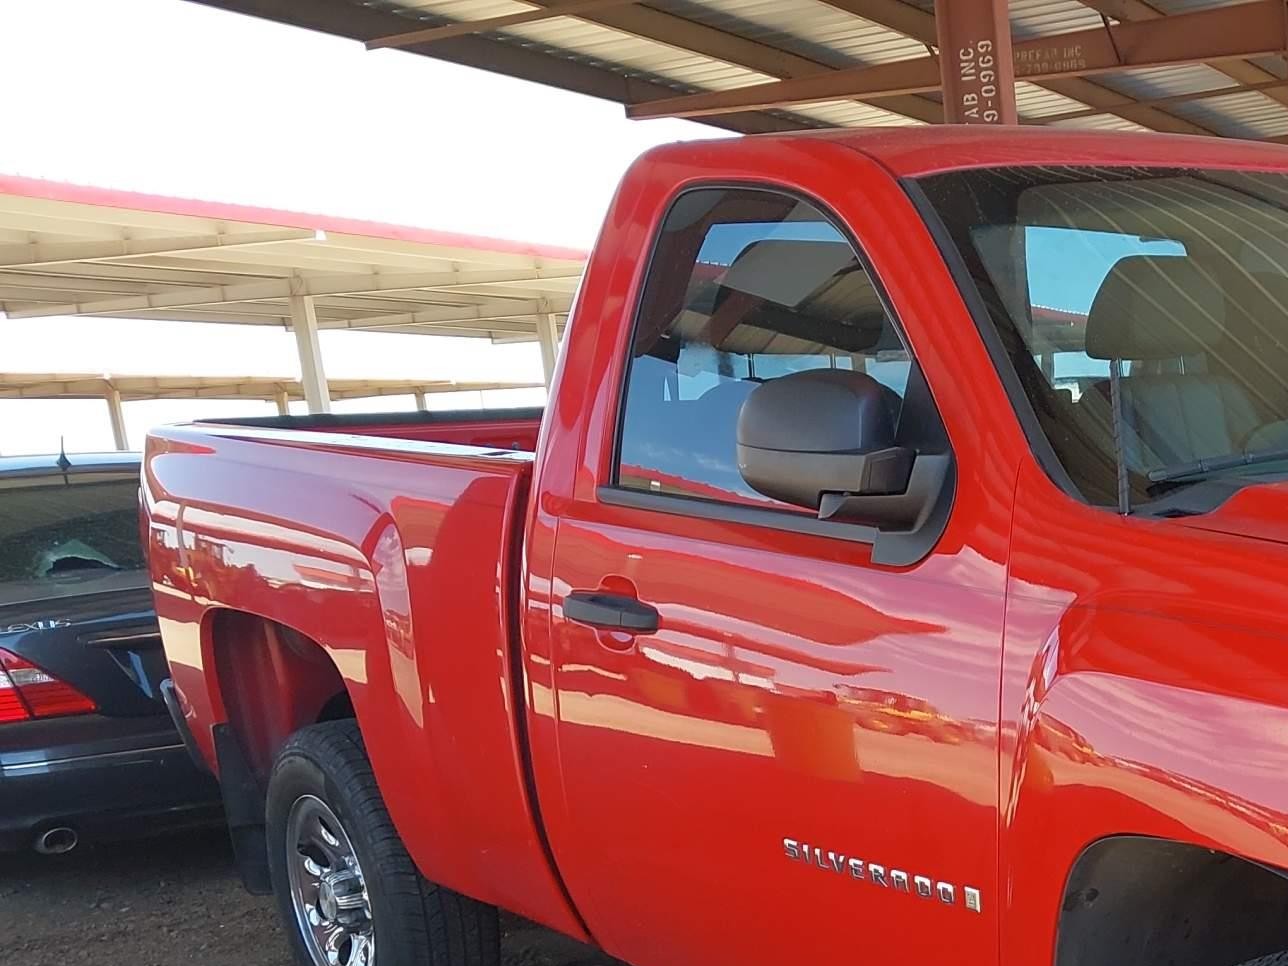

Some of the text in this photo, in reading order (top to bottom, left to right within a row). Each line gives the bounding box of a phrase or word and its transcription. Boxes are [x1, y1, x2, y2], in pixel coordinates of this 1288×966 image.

[959, 40, 979, 121] AB INC.
[2, 618, 73, 634] EXUS
[783, 837, 956, 905] SILVERADO
